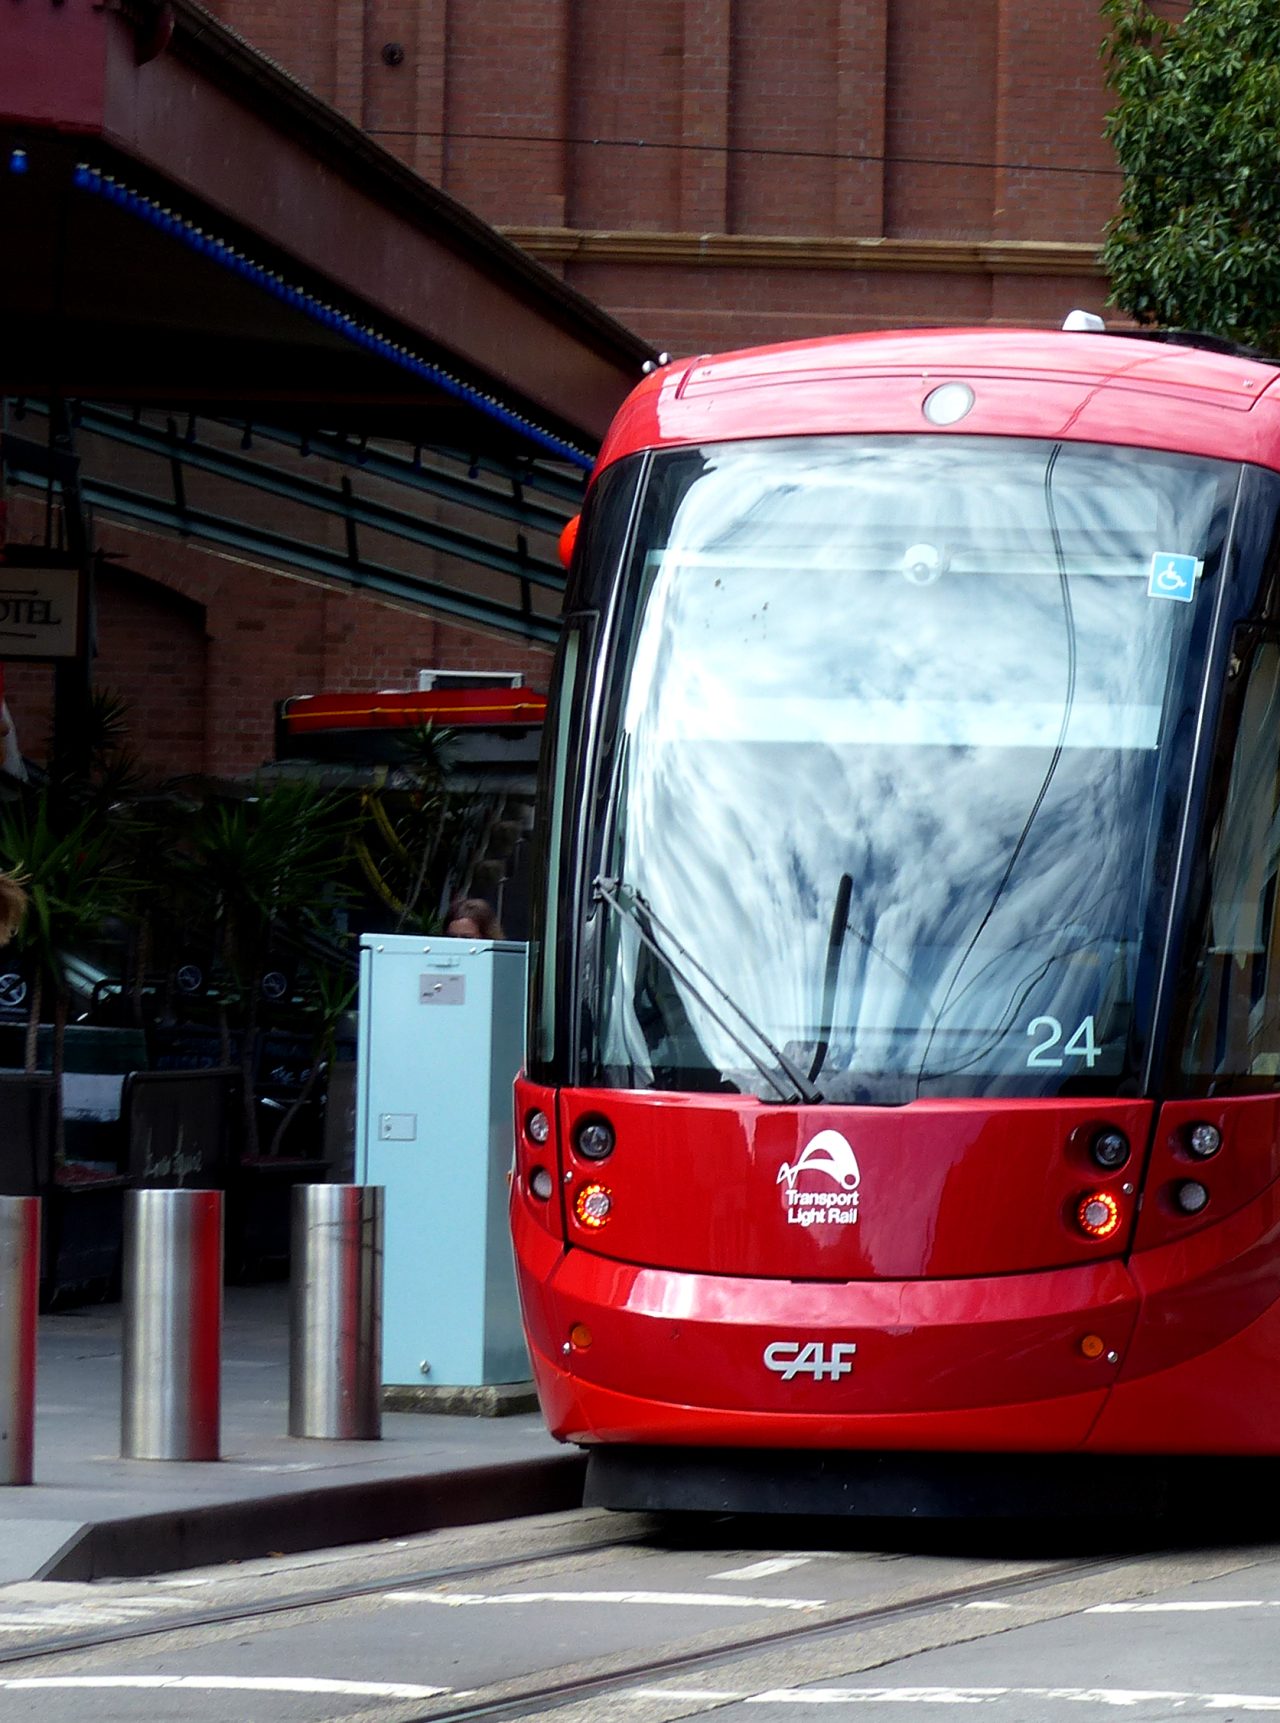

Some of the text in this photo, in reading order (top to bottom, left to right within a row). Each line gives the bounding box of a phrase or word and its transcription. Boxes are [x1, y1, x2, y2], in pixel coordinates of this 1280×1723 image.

[1026, 1015, 1102, 1068] 24
[785, 1189, 859, 1208] Transport
[788, 1208, 858, 1227] Light Rail
[763, 1341, 857, 1381] CAF
